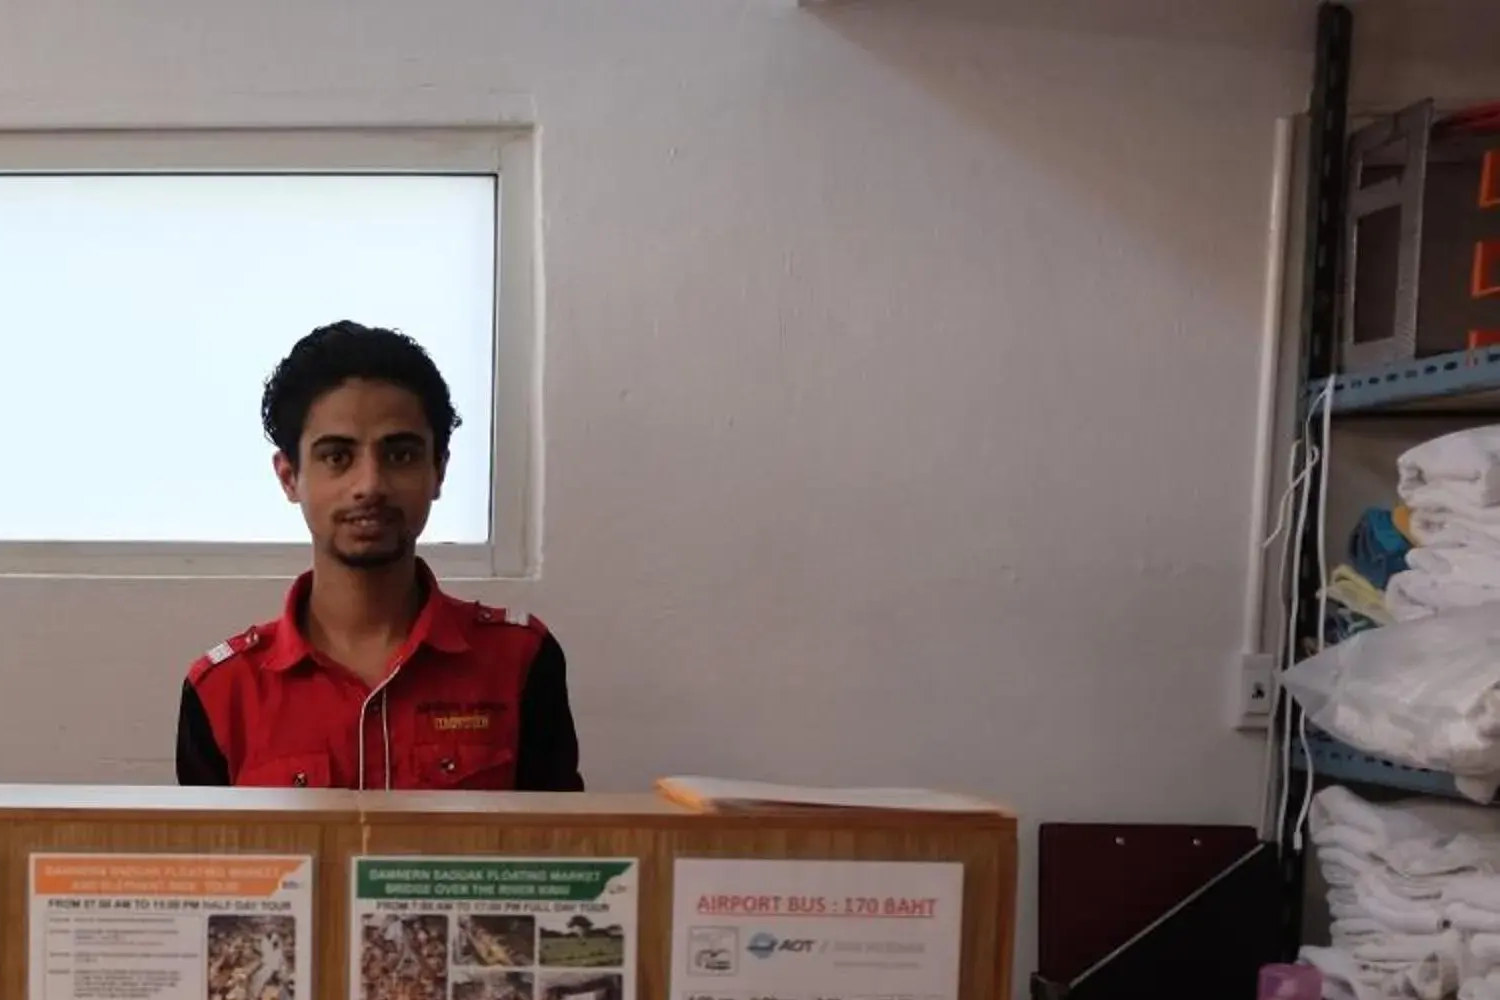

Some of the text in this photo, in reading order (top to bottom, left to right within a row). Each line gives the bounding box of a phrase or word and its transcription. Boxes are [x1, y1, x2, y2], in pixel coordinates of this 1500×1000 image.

[697, 895, 781, 913] AIRPORT
[787, 897, 826, 915] BUS
[844, 898, 878, 915] 170
[884, 899, 938, 916] BAHT
